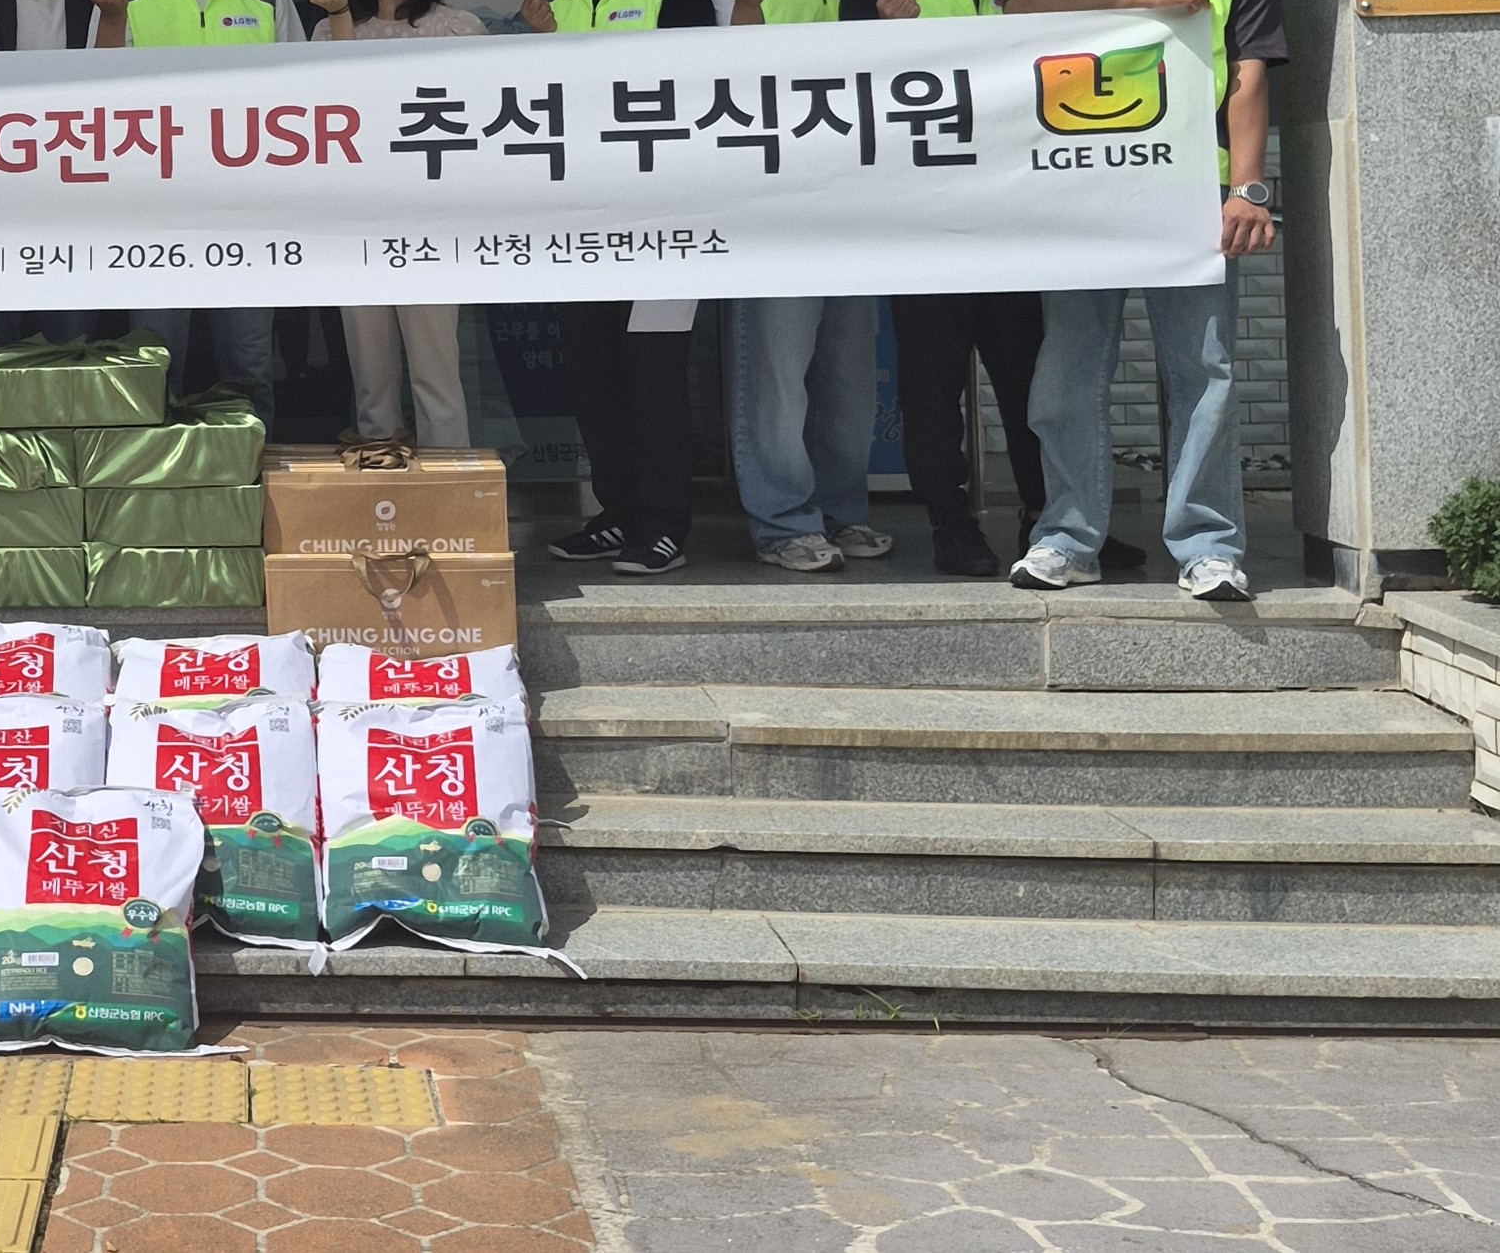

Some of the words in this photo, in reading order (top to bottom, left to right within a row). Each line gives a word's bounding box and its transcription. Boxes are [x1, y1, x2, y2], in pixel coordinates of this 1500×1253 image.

[210, 103, 364, 168] USR
[389, 82, 565, 181] 추석
[600, 68, 978, 175] 부식지원
[1030, 146, 1095, 171] LGE
[1104, 142, 1174, 168] USR
[18, 243, 75, 275] 일시
[107, 243, 194, 270] 2026.
[205, 242, 252, 269] 09.
[276, 241, 304, 266] 18
[381, 236, 442, 268] 장소
[473, 233, 532, 266] 산청
[544, 228, 730, 264] 신등면사무소
[173, 675, 251, 691] 메뚜기쌀
[383, 681, 463, 695] 메뚜기쌀
[162, 751, 251, 791] 산청
[374, 753, 466, 796] 산청
[196, 796, 252, 817] 뚜기쌀
[384, 799, 468, 821] 메뚜기쌀
[50, 818, 121, 839] 지리산
[36, 841, 128, 879] 산청
[42, 878, 129, 900] 메뚜기쌀
[126, 909, 161, 922] 우수상
[268, 902, 289, 915] RPC
[491, 905, 513, 916] RPC
[8, 1002, 36, 1013] NH
[88, 1007, 142, 1021] 산청군농협
[143, 1010, 165, 1022] RPC
